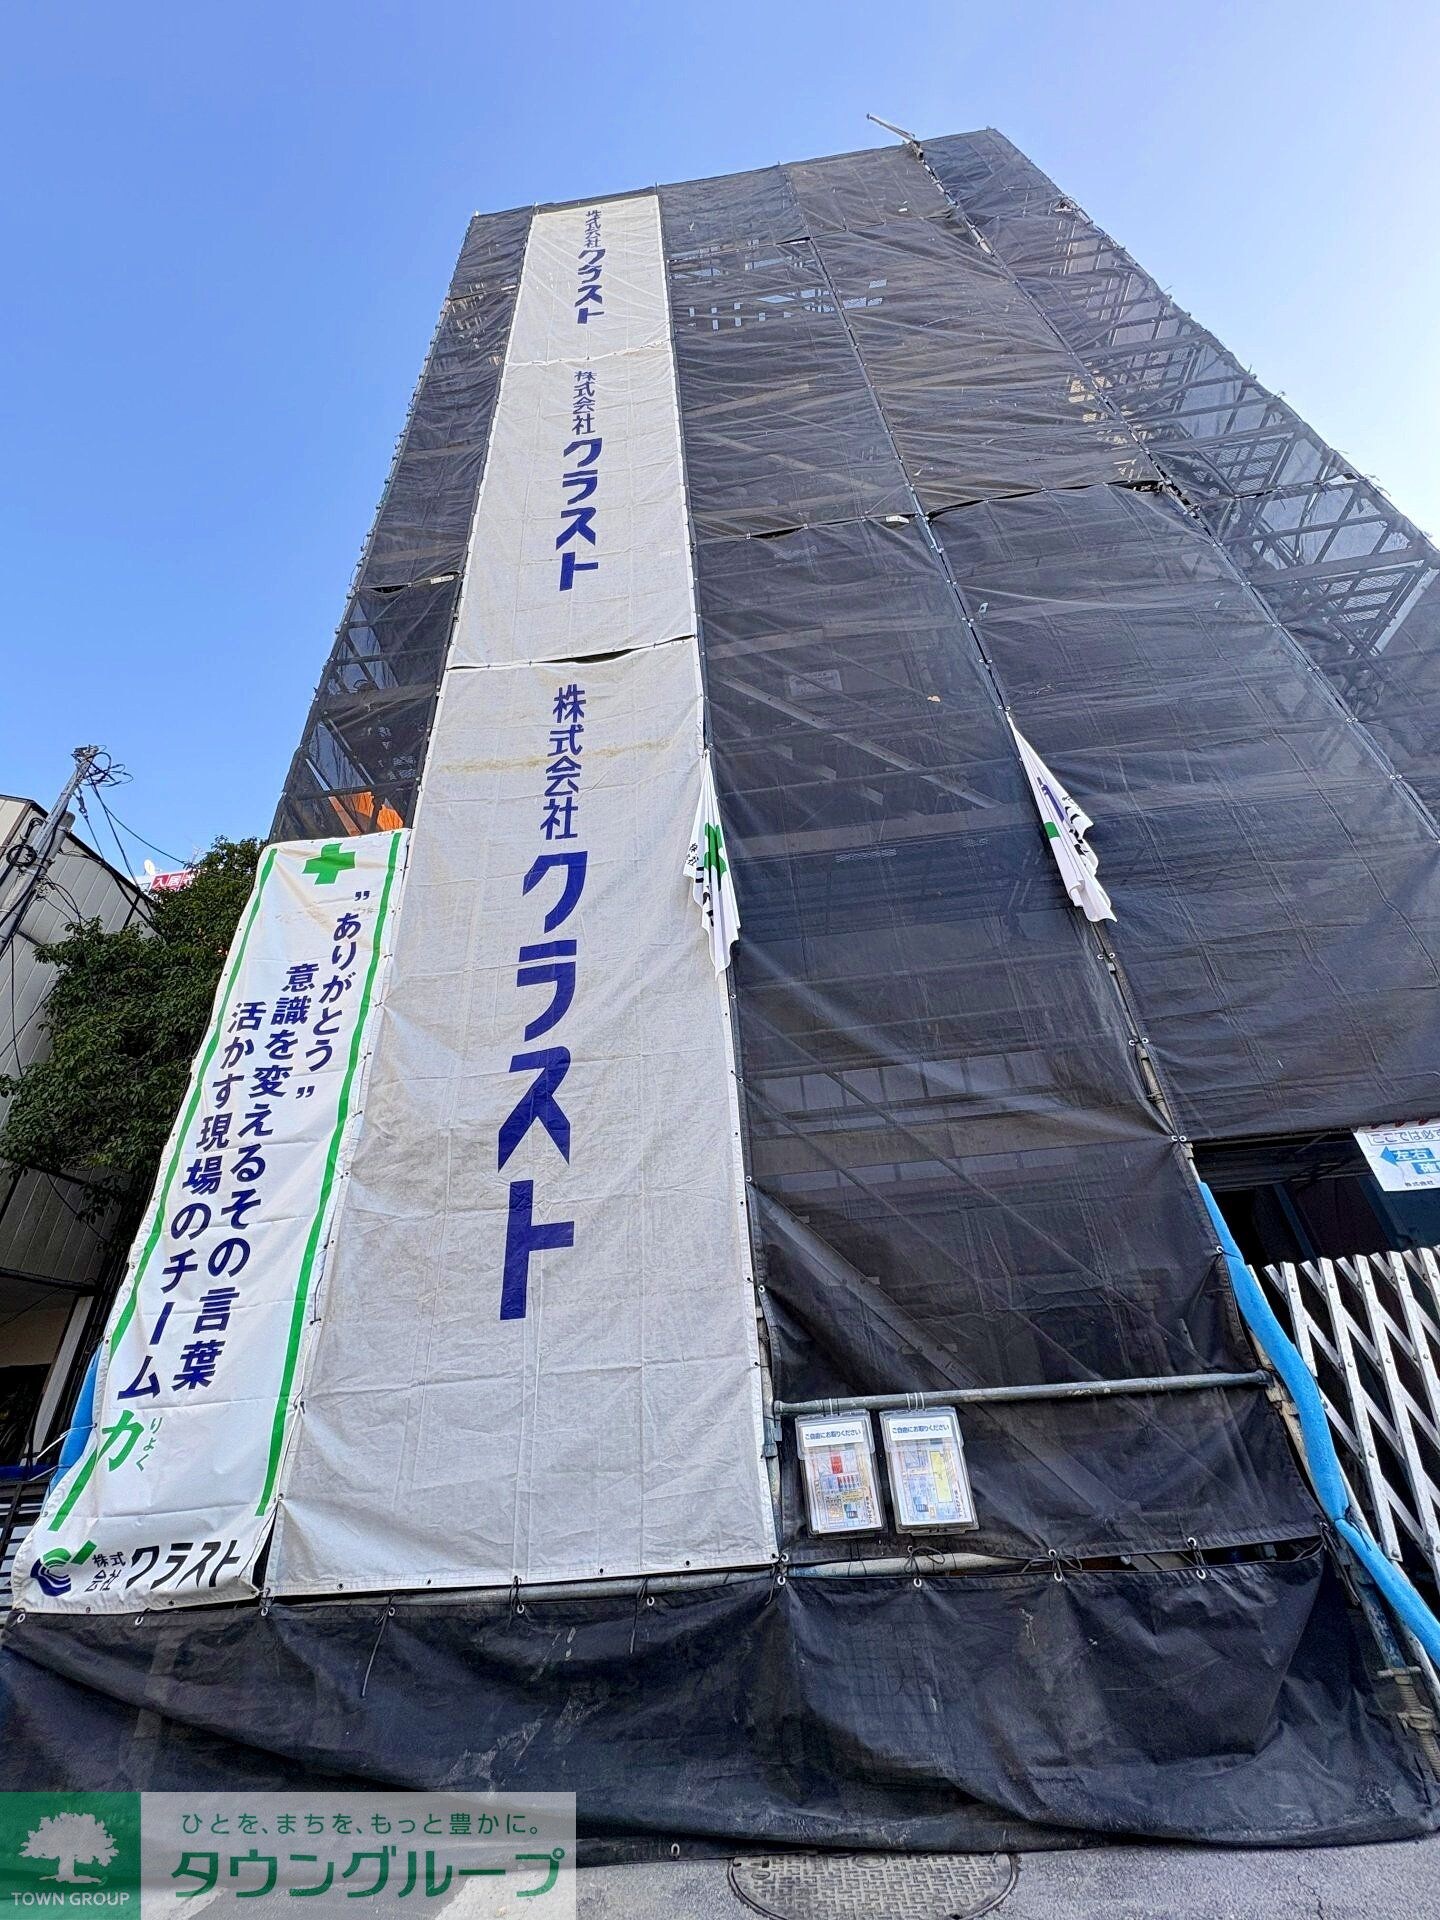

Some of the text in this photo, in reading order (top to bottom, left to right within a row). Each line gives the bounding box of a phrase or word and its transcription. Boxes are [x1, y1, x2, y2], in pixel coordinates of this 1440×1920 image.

[574, 209, 606, 325] 株式会社クラスト
[555, 370, 604, 592] 株式会社クラスト
[498, 683, 588, 1322] 株式会社クラスト
[172, 962, 320, 1391] 意識を変えるその言葉
[136, 1416, 162, 1472] りょく
[92, 1551, 126, 1567] 株式
[124, 1539, 241, 1590] クラスト
